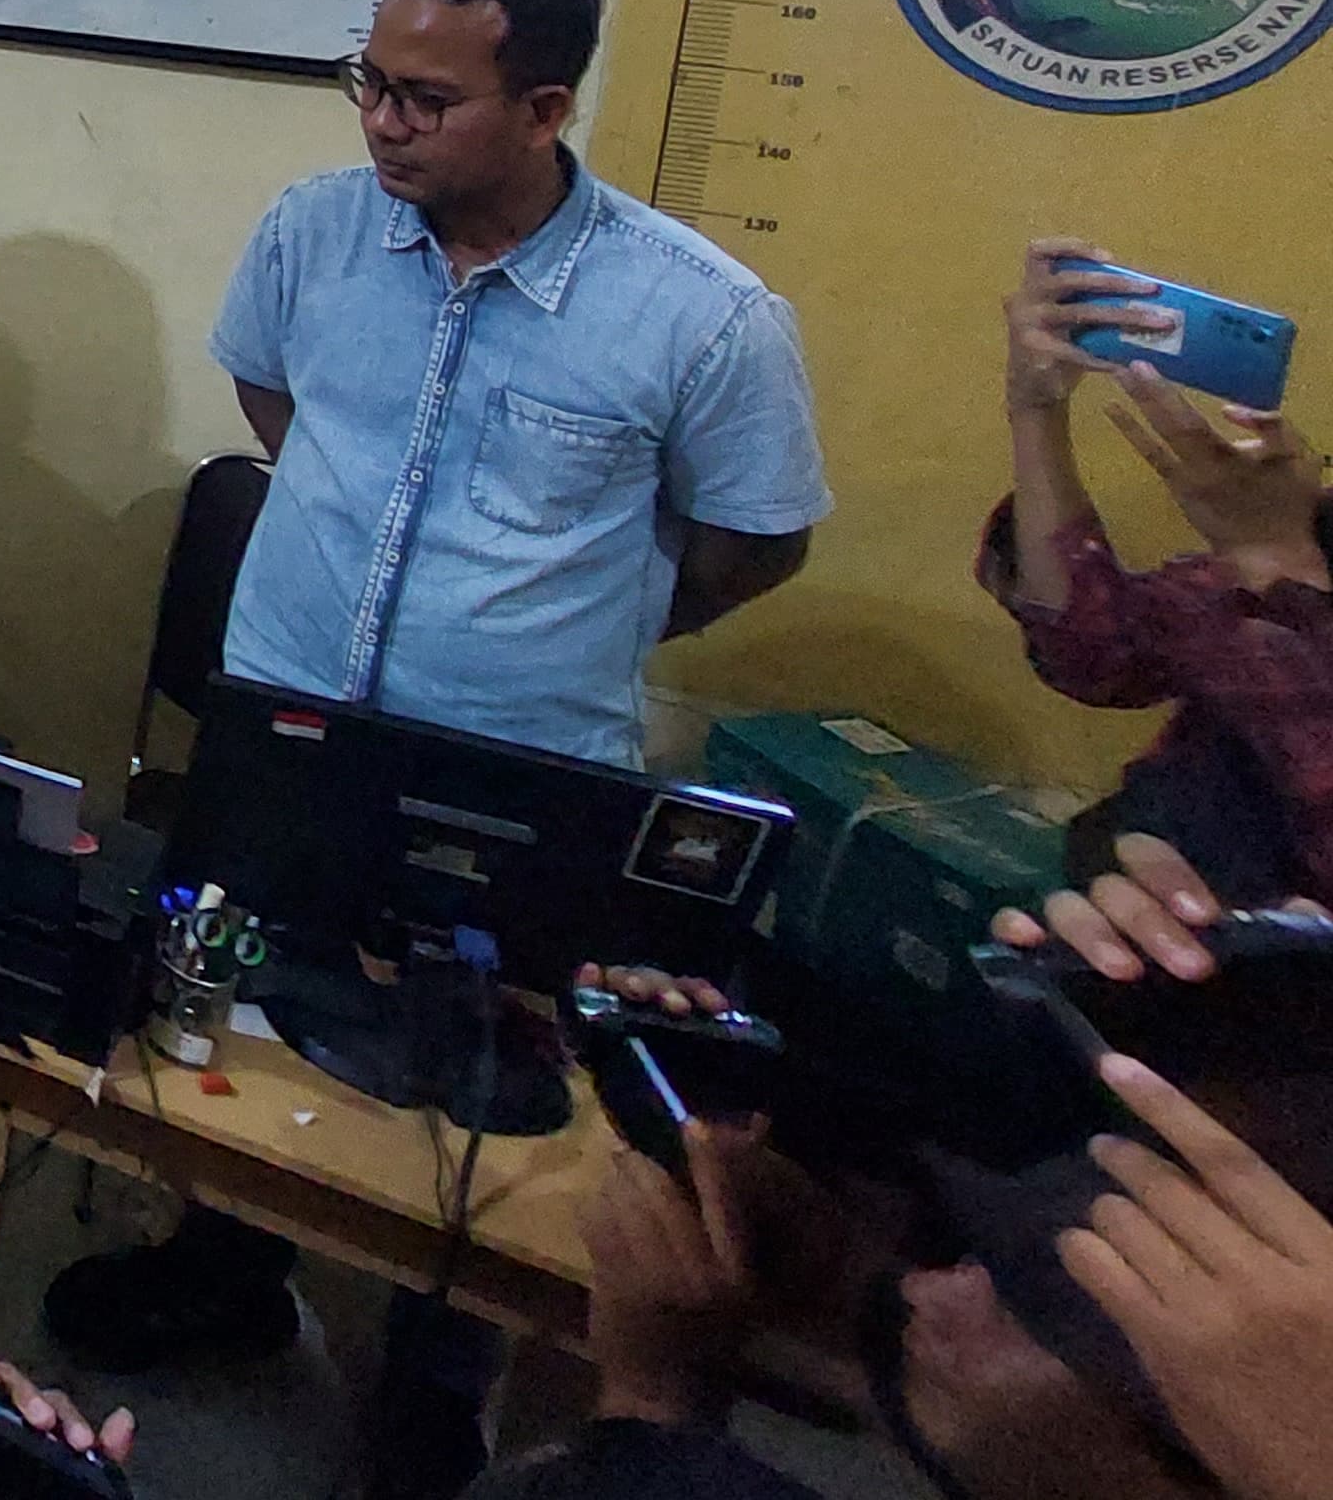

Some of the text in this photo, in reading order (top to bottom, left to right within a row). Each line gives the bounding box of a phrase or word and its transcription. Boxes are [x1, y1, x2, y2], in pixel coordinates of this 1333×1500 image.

[781, 4, 817, 20] 160
[970, 22, 1089, 86] SATUAN
[1099, 34, 1261, 87] RESERSE
[757, 142, 791, 161] 140
[744, 216, 778, 232] 130
